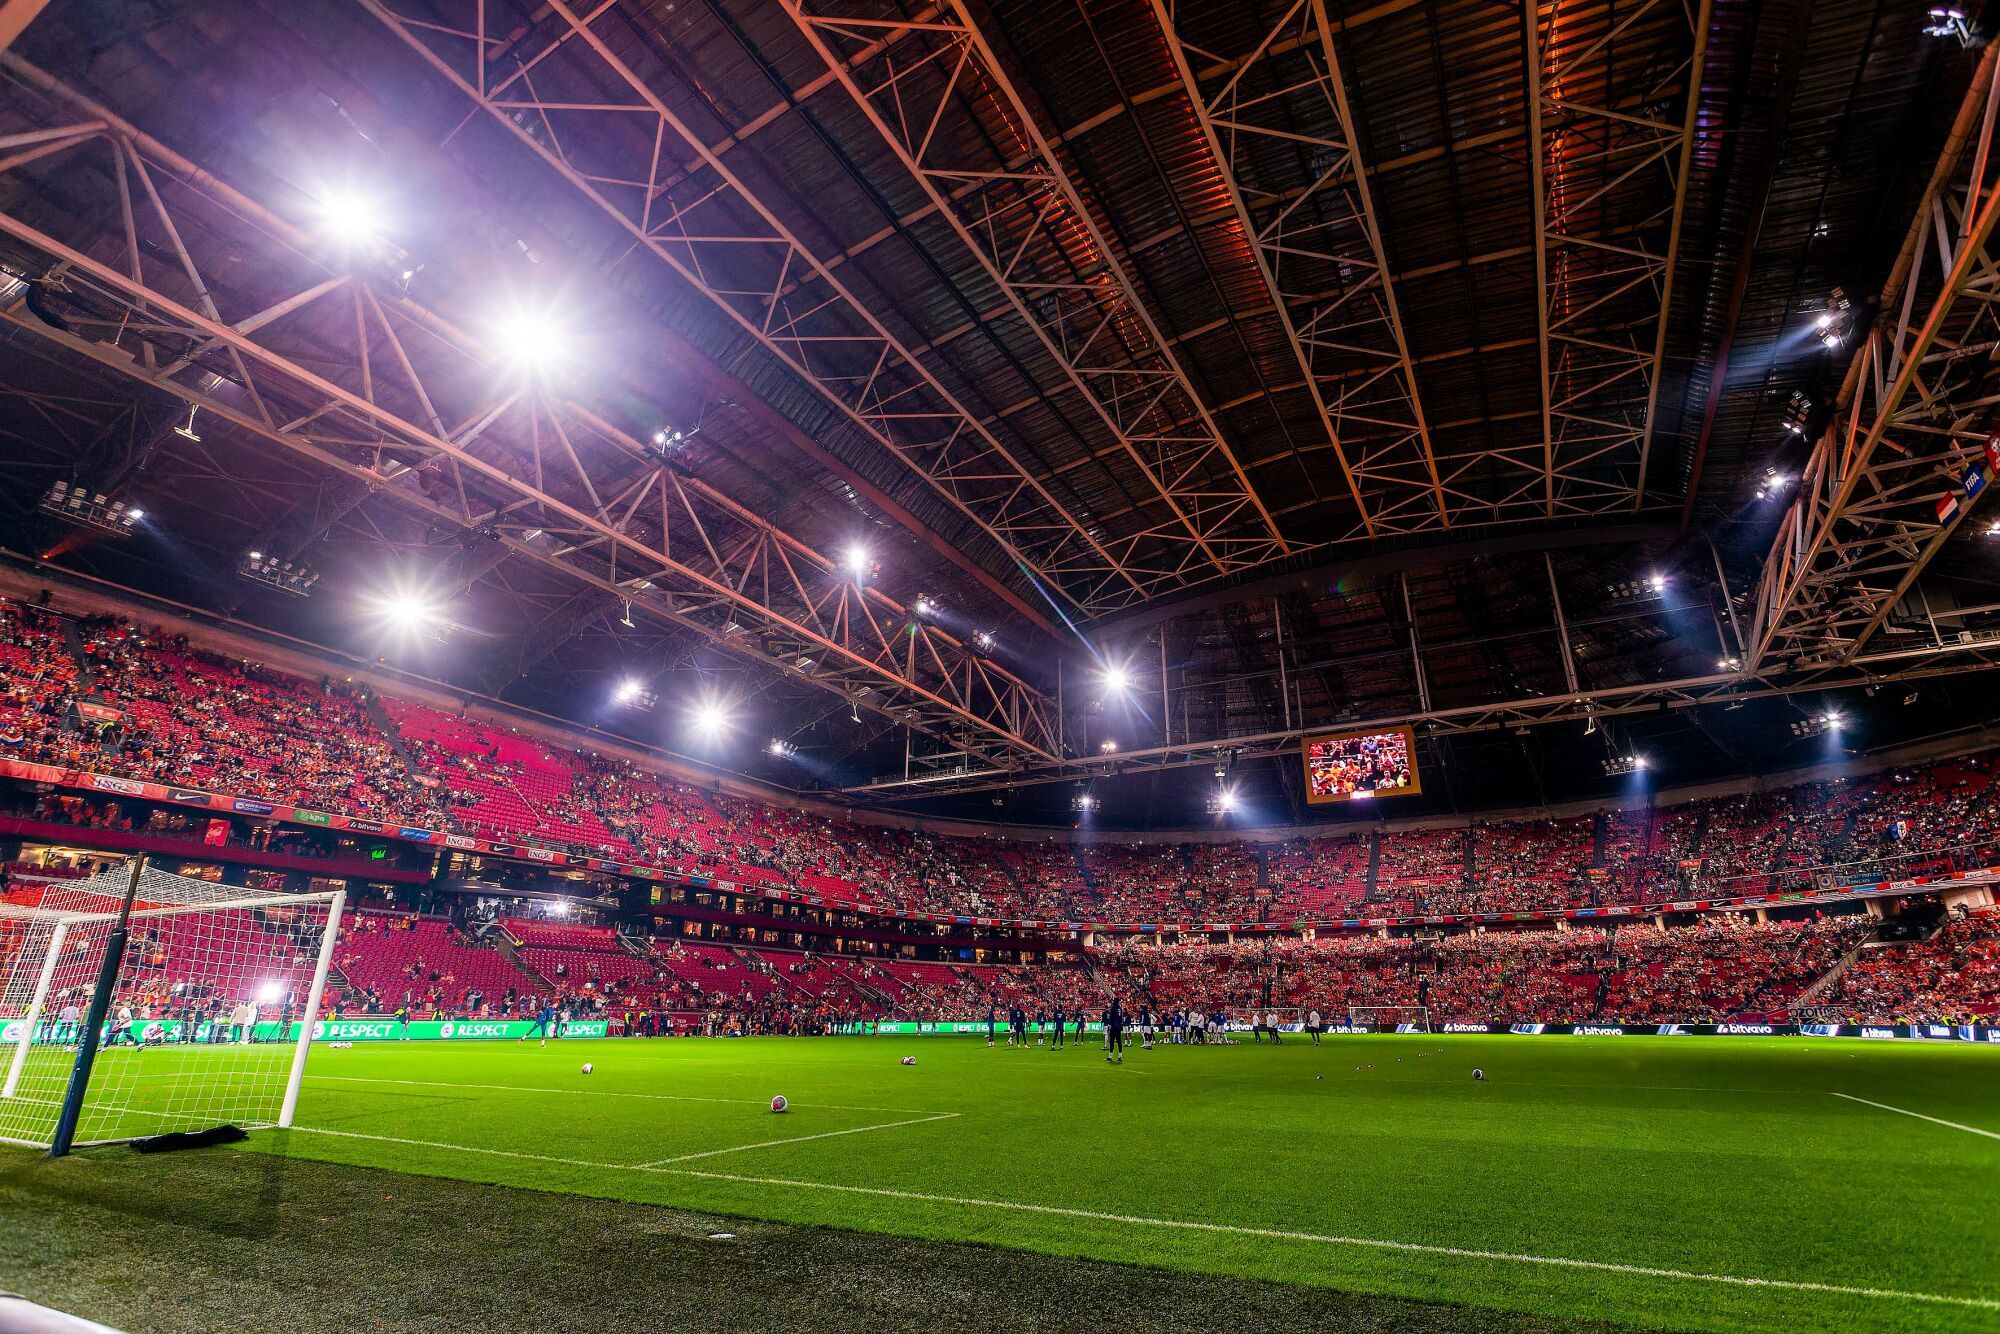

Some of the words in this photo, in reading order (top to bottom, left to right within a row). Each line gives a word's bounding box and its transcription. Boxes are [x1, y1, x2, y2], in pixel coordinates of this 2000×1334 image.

[1965, 471, 1980, 491] FIFA
[309, 813, 325, 822] kpn
[357, 820, 382, 832] bitvavo
[328, 1024, 394, 1037] RESPECT
[457, 1024, 509, 1036] RESPECT
[880, 1024, 901, 1032] RESPECT
[1230, 1023, 1254, 1031] bitvav
[1453, 1023, 1488, 1032] bitvavo
[1584, 1026, 1623, 1035] bitvavo
[1729, 1024, 1773, 1034] bitvavo
